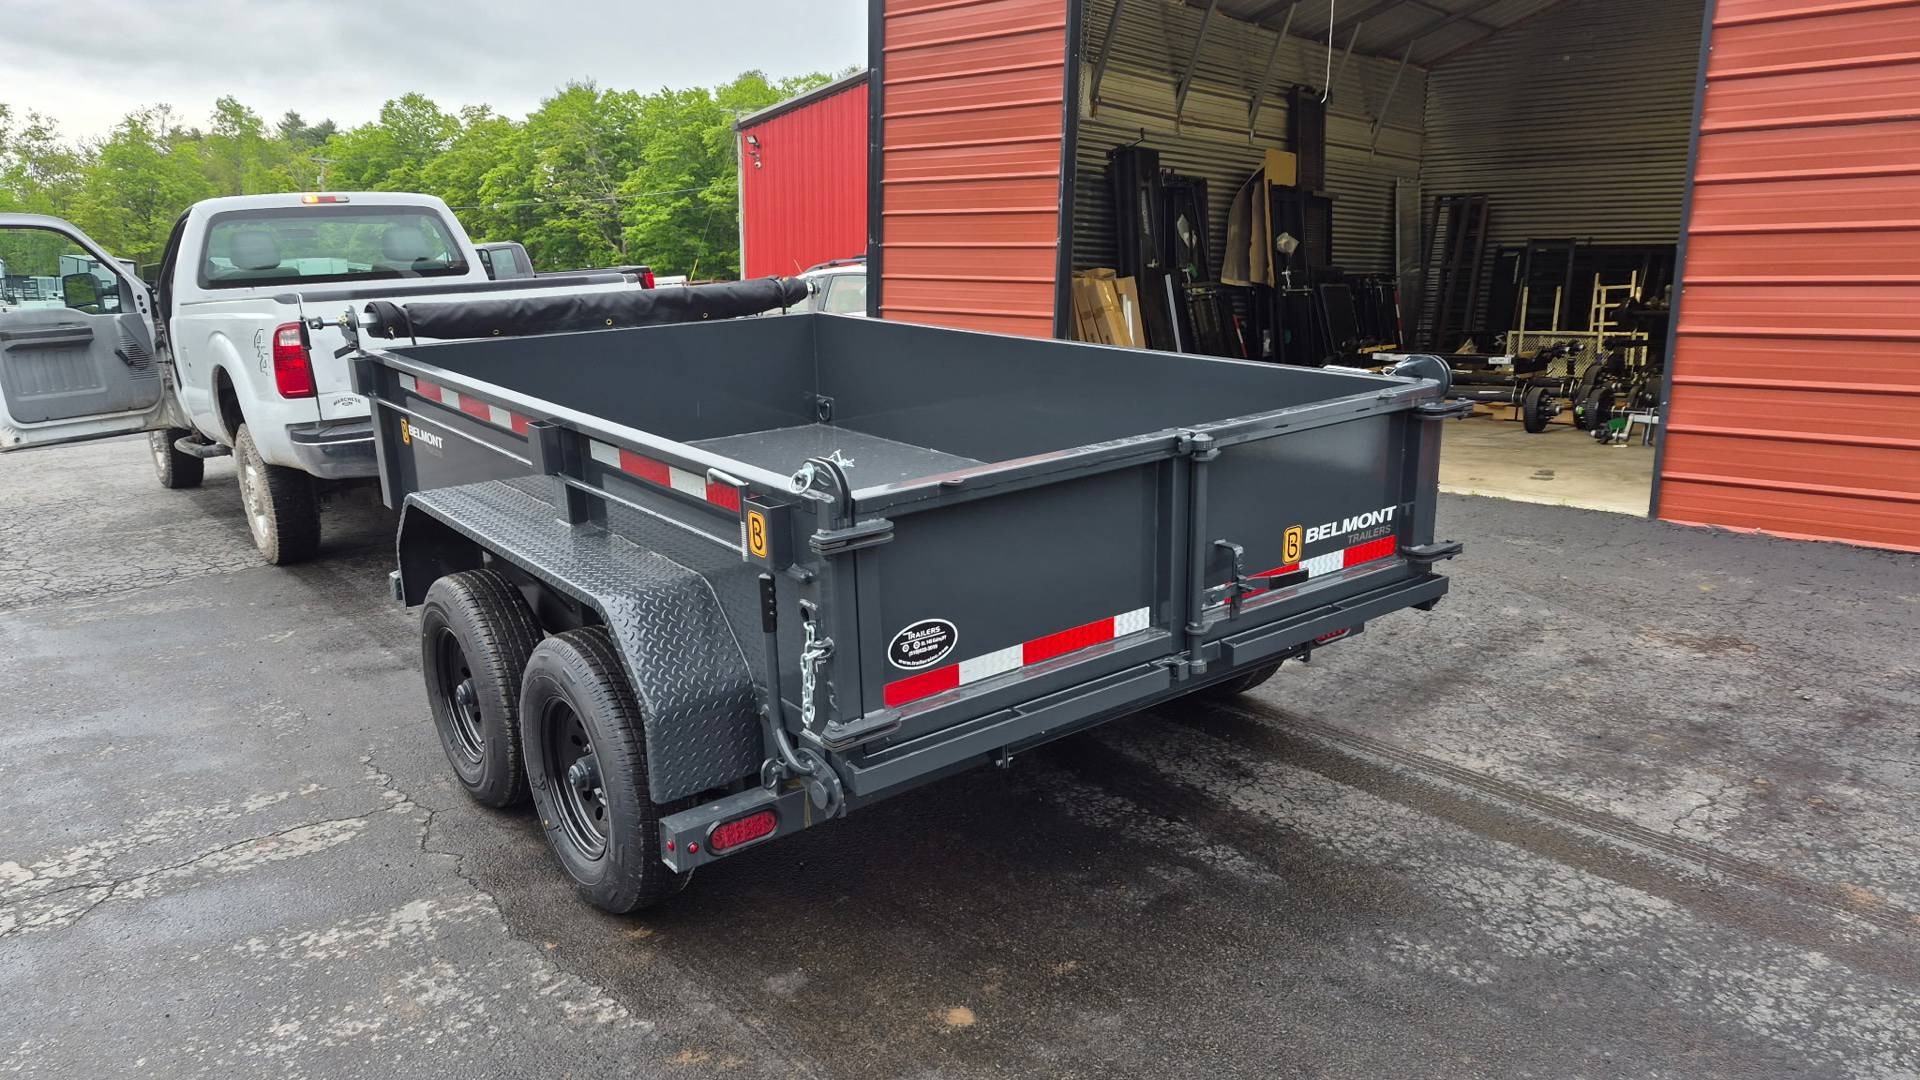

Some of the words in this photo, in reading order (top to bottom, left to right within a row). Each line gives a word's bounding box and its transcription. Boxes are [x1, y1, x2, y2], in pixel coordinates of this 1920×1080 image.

[408, 424, 443, 449] BELMONT
[1305, 505, 1397, 544] BELMONT
[1347, 524, 1391, 545] TRAILERS
